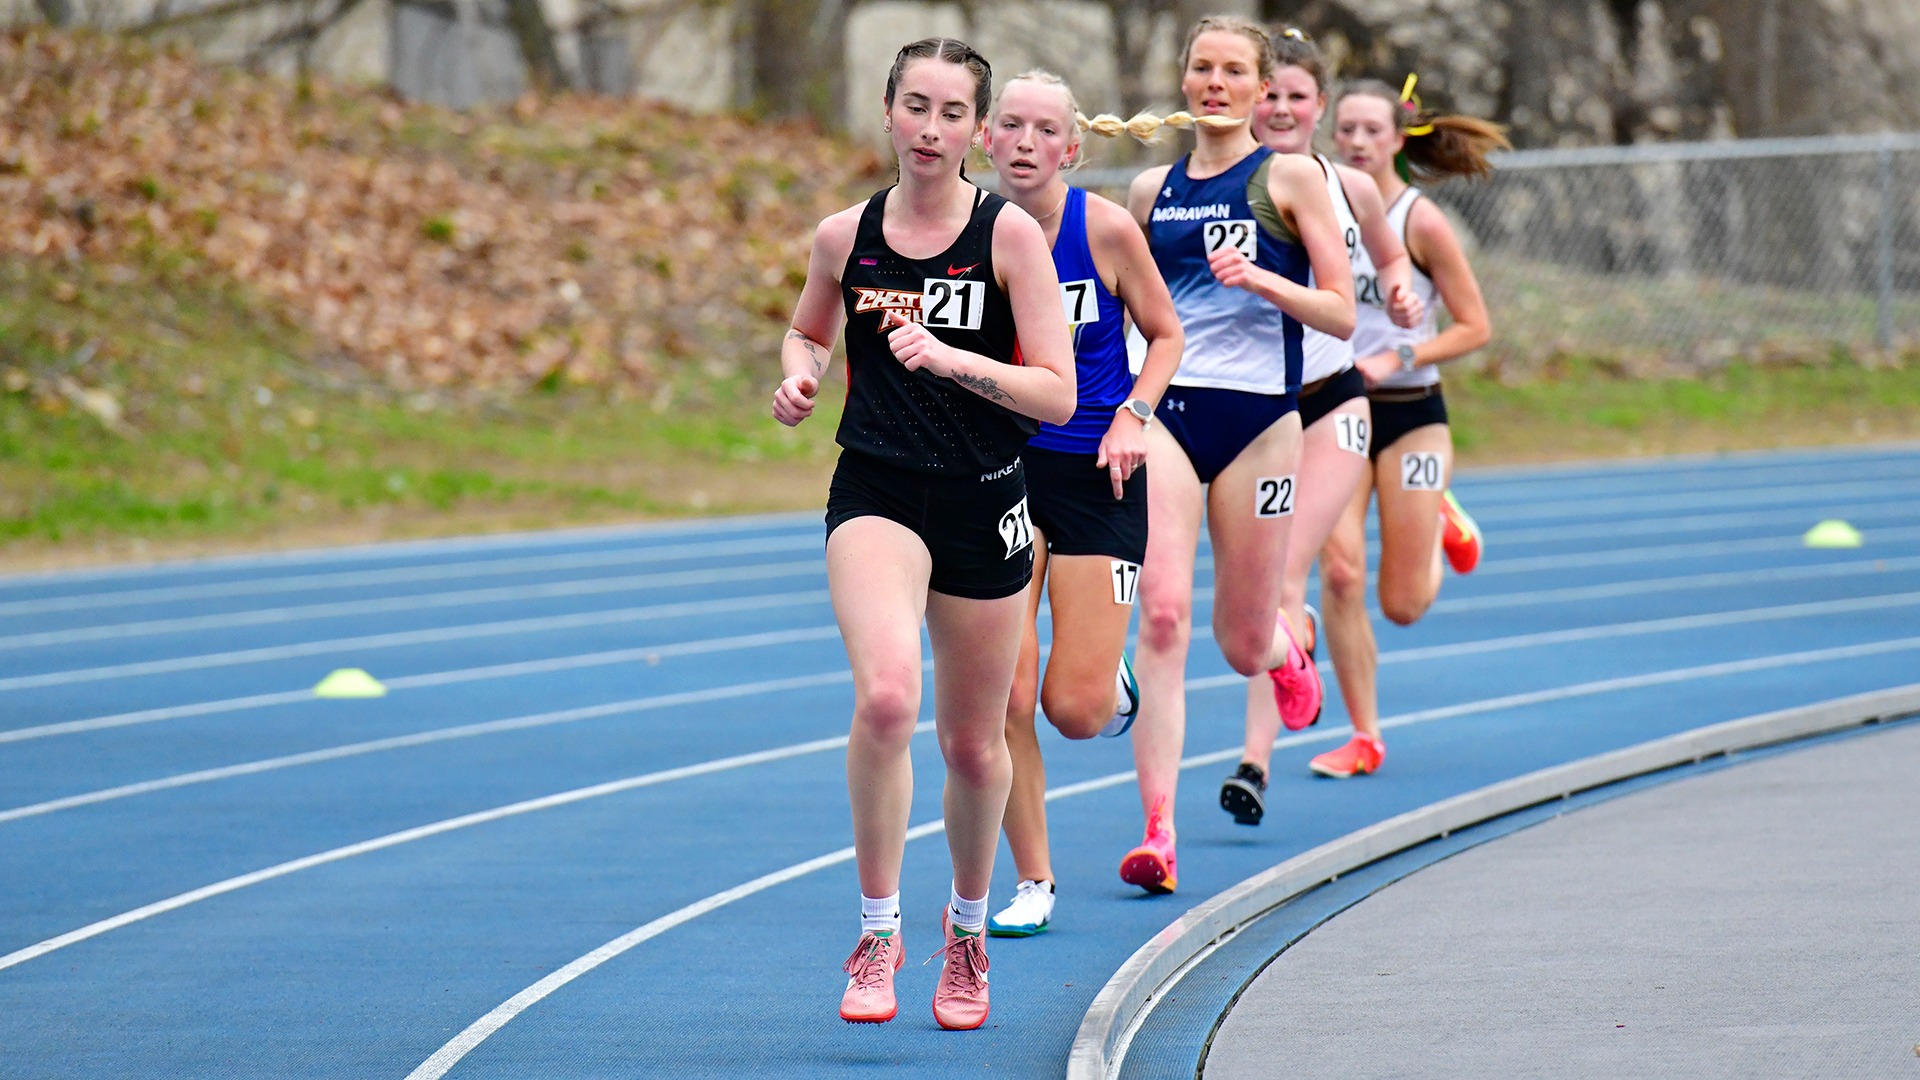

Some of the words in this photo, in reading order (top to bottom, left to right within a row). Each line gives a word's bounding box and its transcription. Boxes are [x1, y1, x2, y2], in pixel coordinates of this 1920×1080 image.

[1152, 203, 1230, 222] MORAVIAN
[1208, 223, 1249, 258] 22
[1346, 227, 1356, 259] 9
[856, 289, 924, 312] CHEST
[927, 281, 972, 327] 21
[1065, 283, 1086, 322] 7
[880, 308, 924, 330] HIL
[1341, 417, 1367, 451] 19
[1406, 454, 1439, 485] 20
[1260, 478, 1292, 515] 22
[1002, 503, 1030, 556] 21
[1115, 564, 1138, 602] 17
